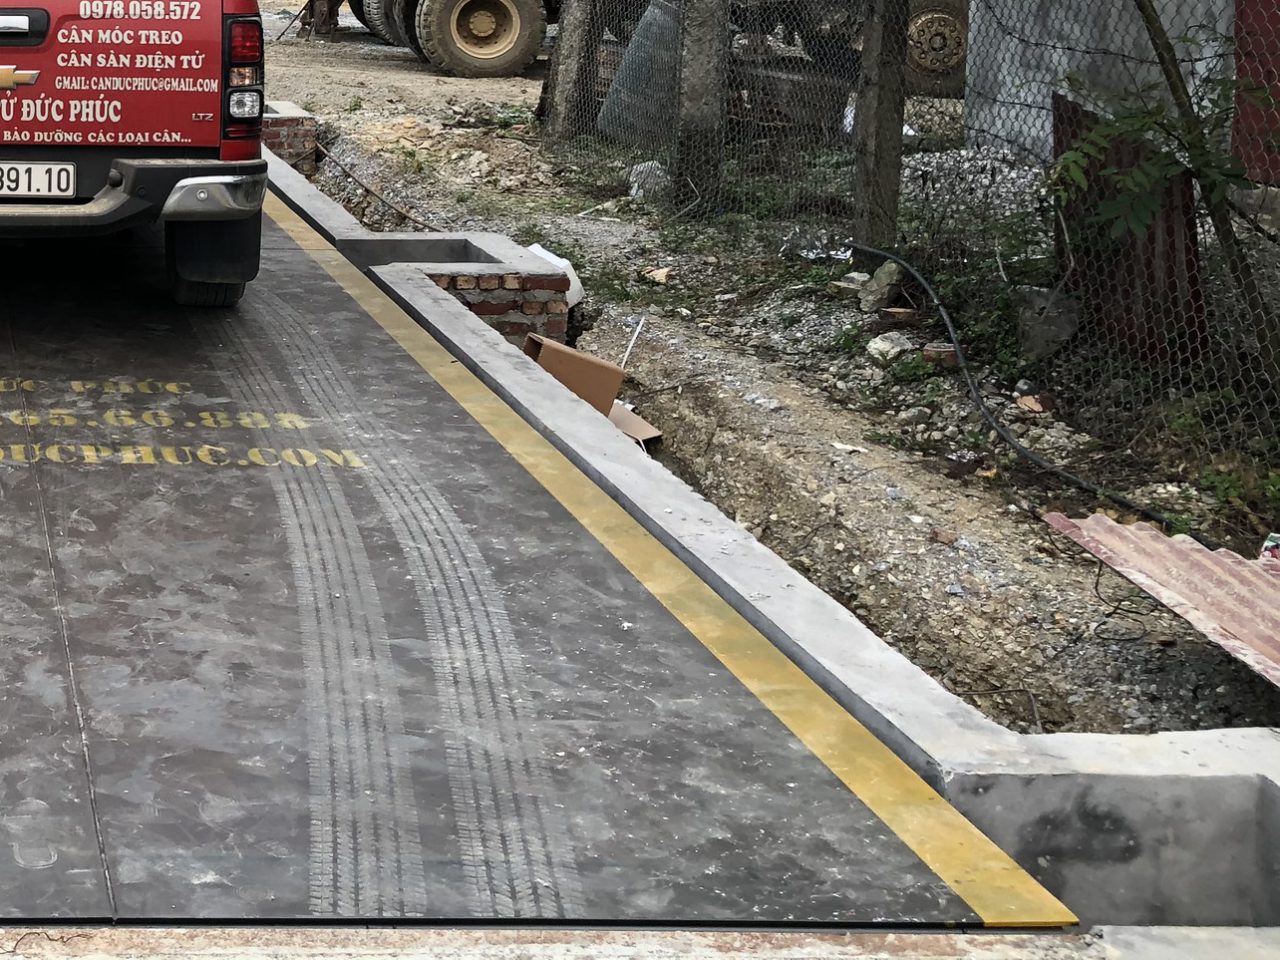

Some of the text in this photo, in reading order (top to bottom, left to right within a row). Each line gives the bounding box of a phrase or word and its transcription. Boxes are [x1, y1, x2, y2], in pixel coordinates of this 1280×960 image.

[79, 0, 202, 20] 0978.058.572
[57, 25, 183, 45] CÂN MÓC TREO
[56, 49, 205, 72] CÂN SÀN ĐIỆN TỬ
[55, 75, 219, 93] GMAIL: CANDUCPHUC@GMAIL.COM
[21, 93, 64, 122] ĐỨC
[69, 93, 122, 123] PHÚC
[192, 113, 214, 121] LTZ
[3, 127, 30, 141] BẢO
[34, 129, 83, 143] DƯỠNG
[87, 129, 115, 143] CÁC
[118, 132, 149, 145] LOẠI
